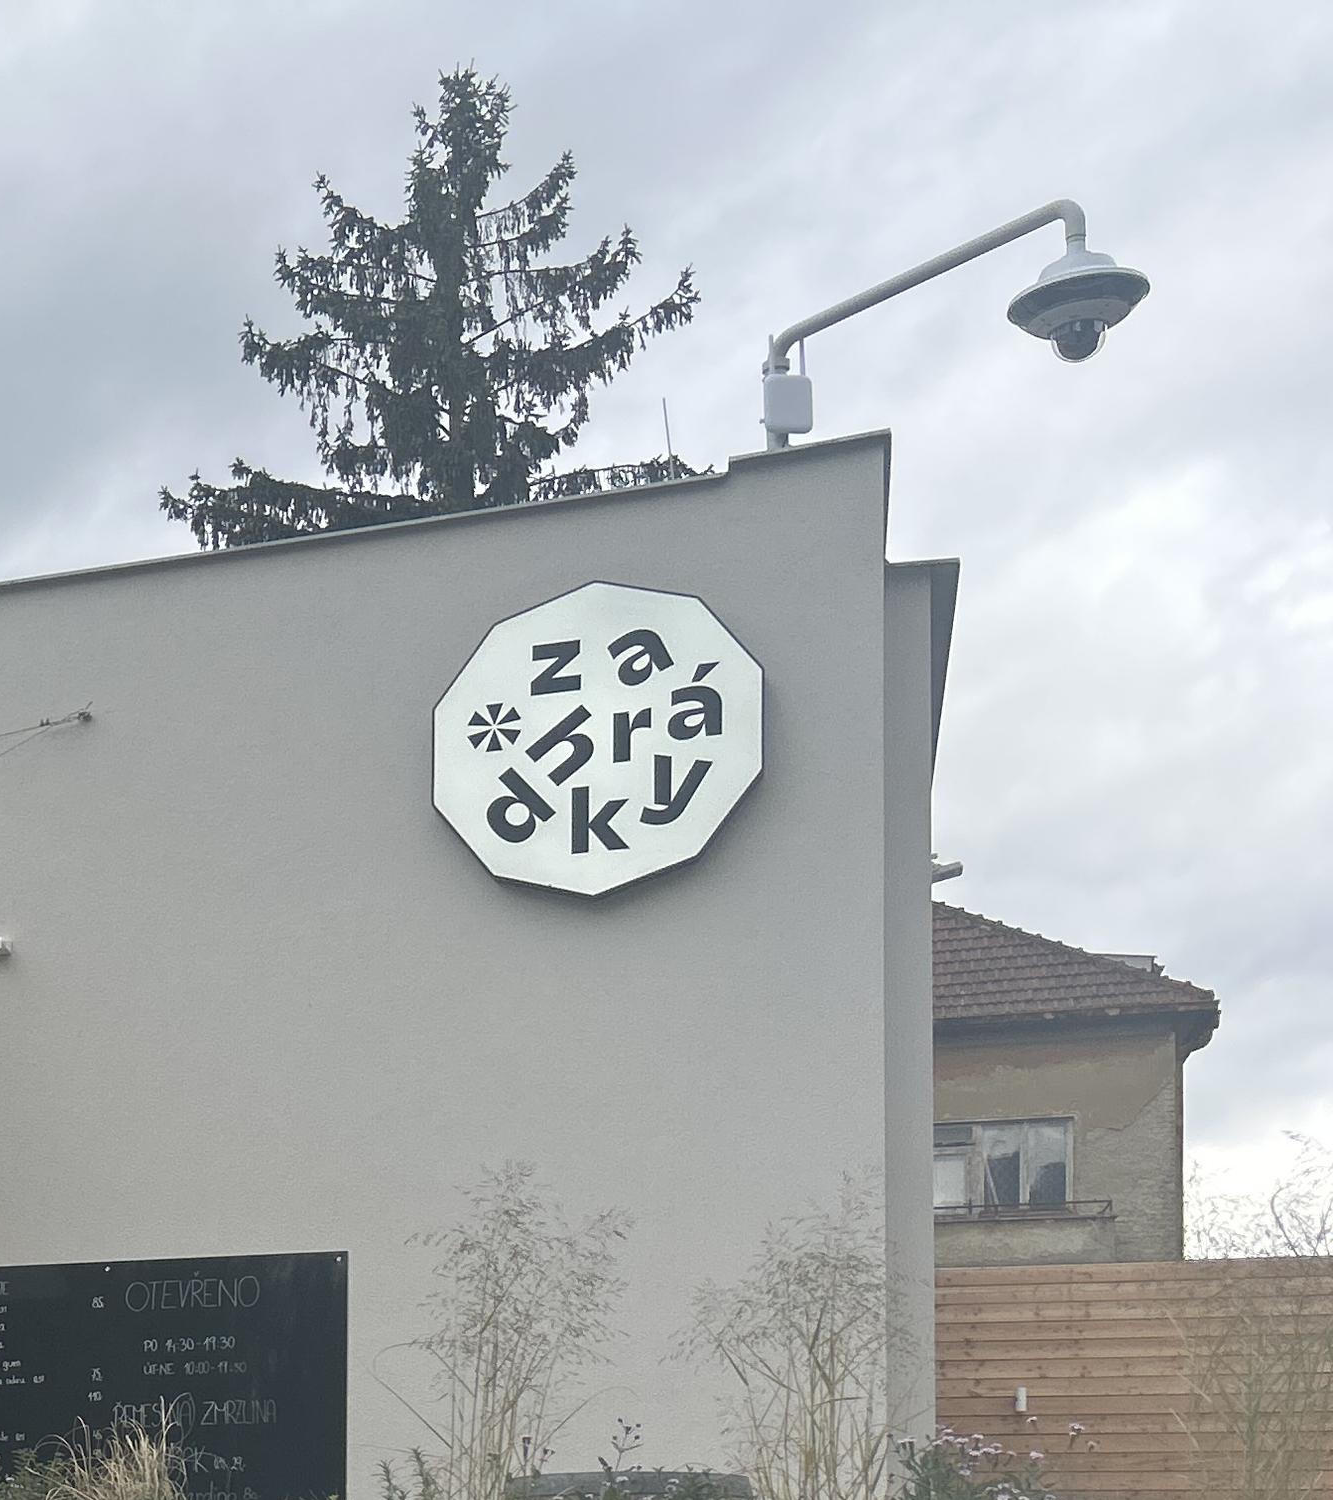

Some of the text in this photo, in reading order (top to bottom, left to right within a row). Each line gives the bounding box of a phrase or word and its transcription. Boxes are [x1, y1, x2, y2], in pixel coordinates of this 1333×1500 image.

[125, 1270, 260, 1312] OTEVŘENO
[143, 1338, 159, 1353] PO
[200, 1398, 277, 1426] ZMRZLINA
